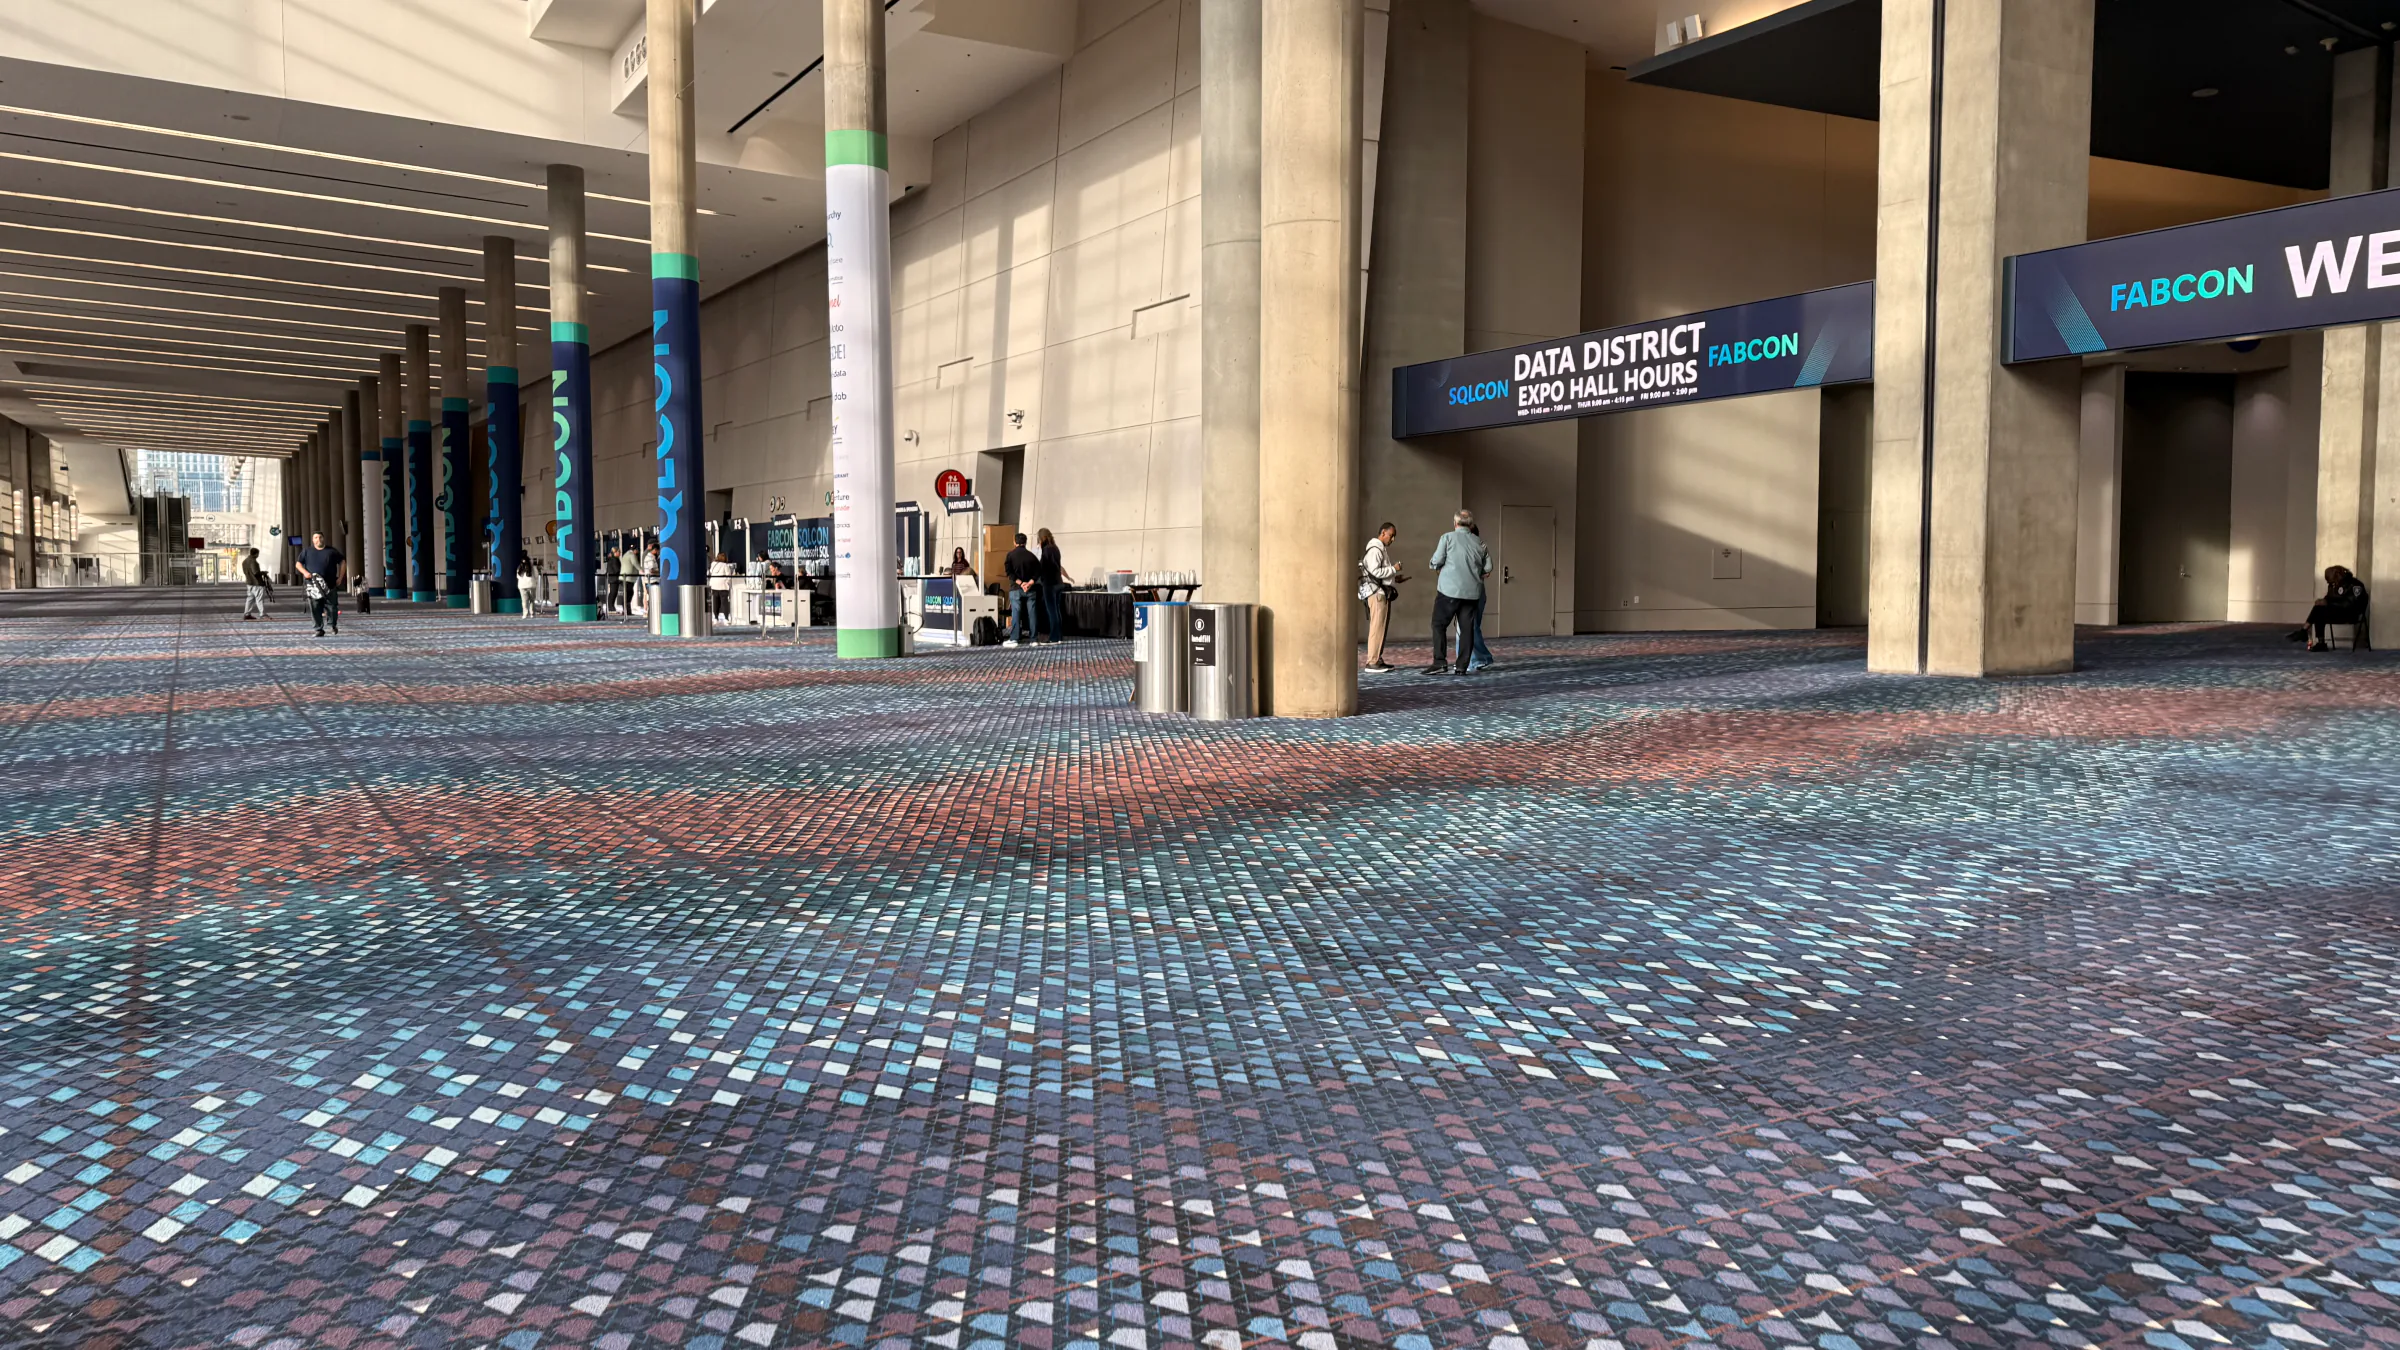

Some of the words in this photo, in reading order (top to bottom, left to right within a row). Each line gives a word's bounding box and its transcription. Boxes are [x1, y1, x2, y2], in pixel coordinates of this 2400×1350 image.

[2111, 264, 2254, 311] FABCON
[2285, 229, 2400, 298] WE
[1514, 345, 1576, 381] DATA
[1583, 321, 1706, 371] DISTRICT
[1709, 332, 1799, 367] FABCON
[1449, 379, 1509, 405] SQLCON
[1518, 380, 1564, 407] EXPO
[1570, 372, 1618, 400] HALL
[1624, 359, 1698, 392] HOURS
[1564, 404, 1573, 412] pm
[1591, 399, 1602, 407] 9:00
[1625, 396, 1634, 404] pm
[1640, 392, 1649, 400] FRI
[1650, 391, 1661, 399] 9:00
[1676, 387, 1687, 396] 2:00
[1688, 387, 1698, 396] pm
[767, 529, 795, 547] FABCON
[798, 527, 829, 547] SQLCON
[784, 548, 795, 558] Fabri
[819, 545, 830, 558] SQL
